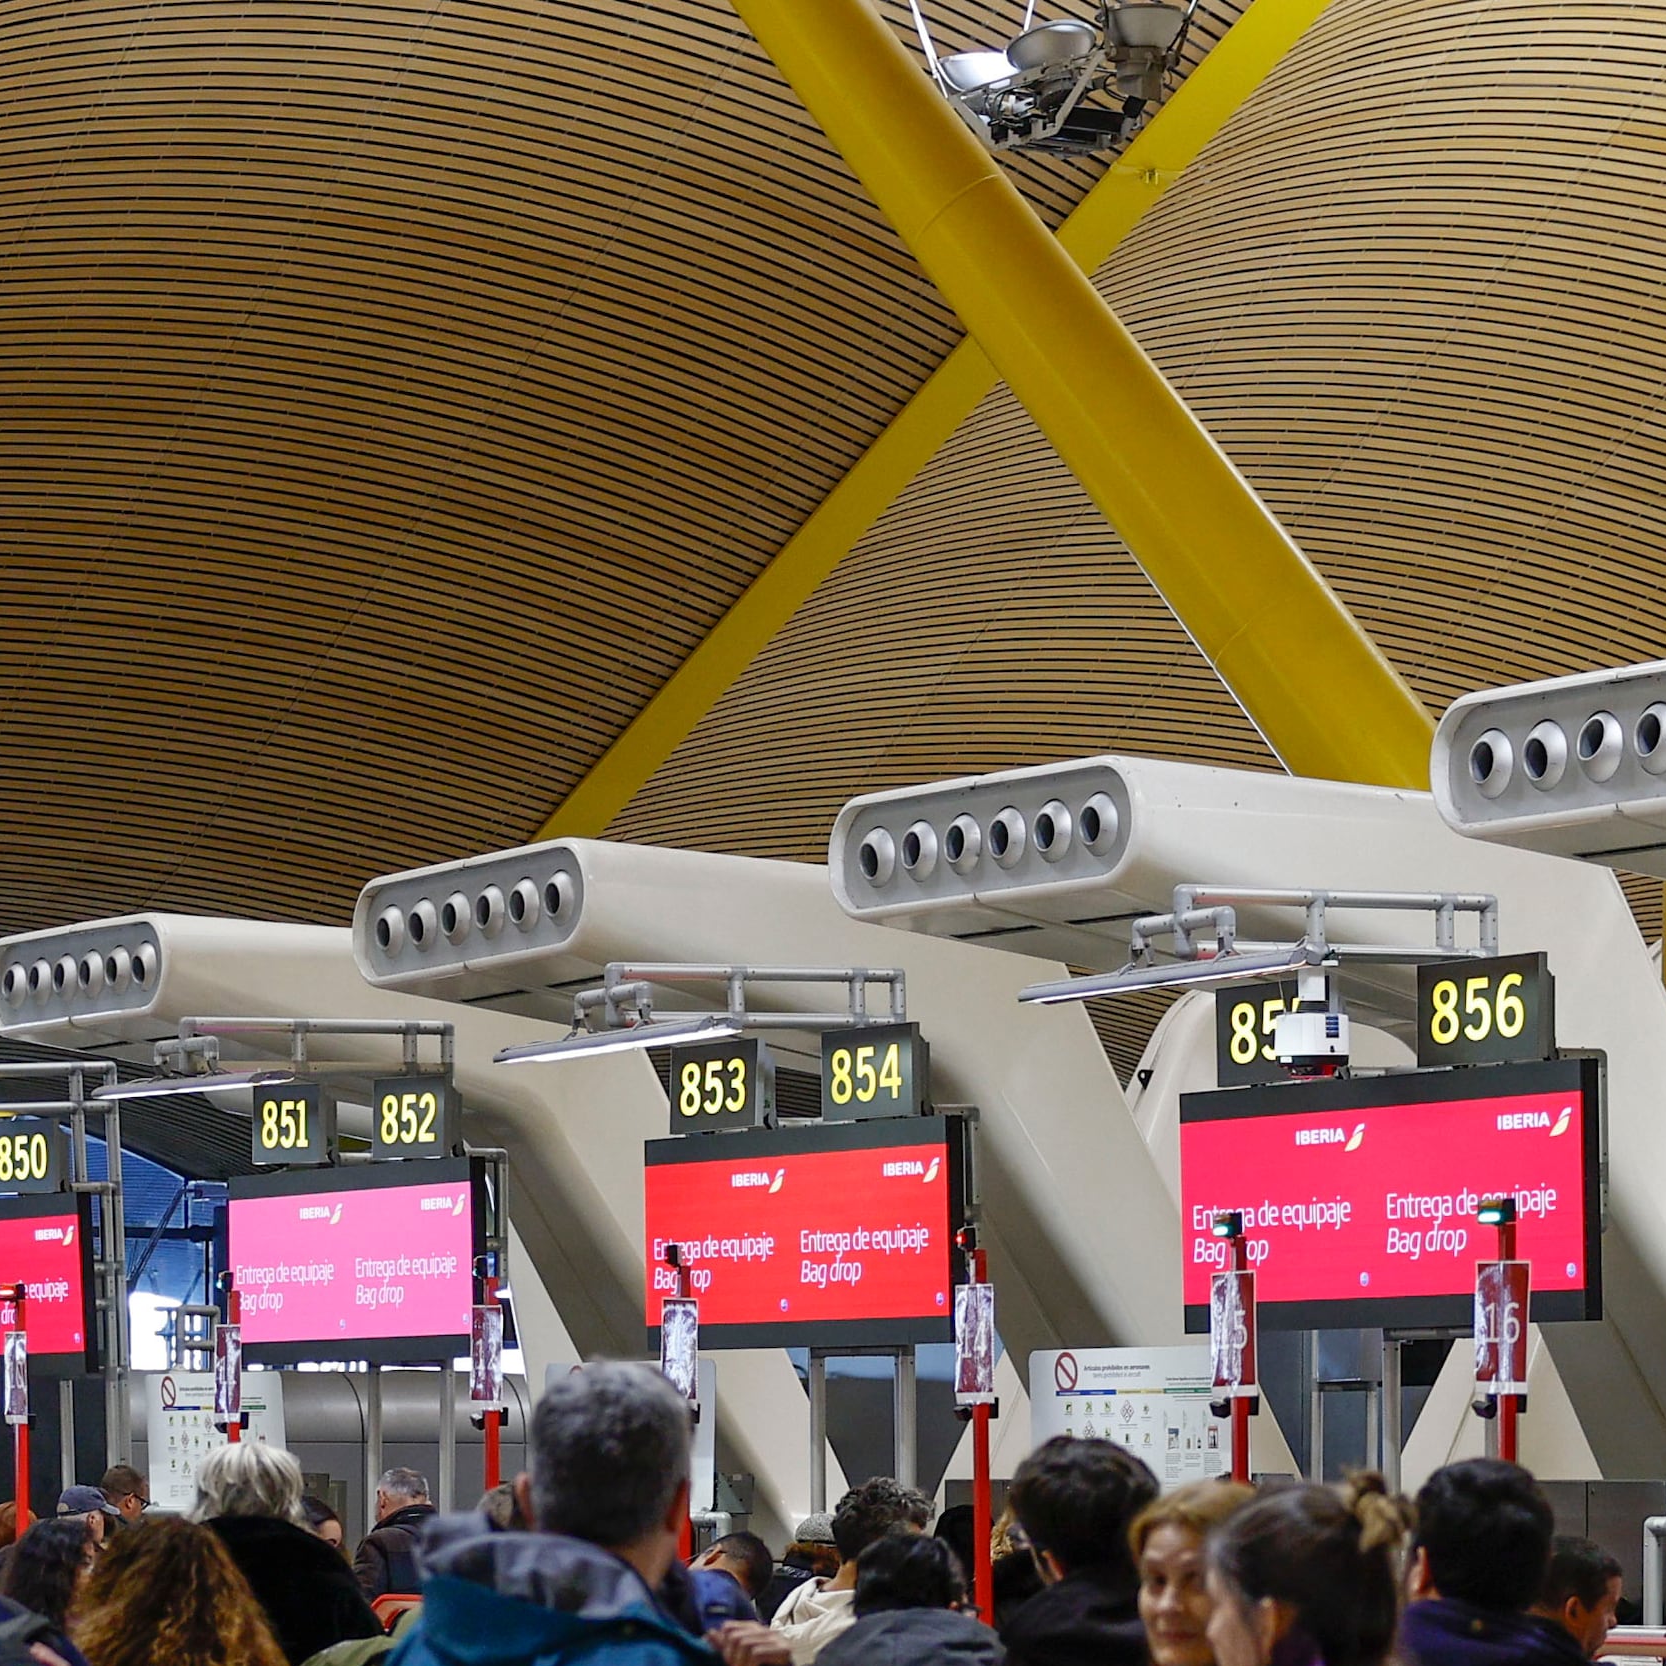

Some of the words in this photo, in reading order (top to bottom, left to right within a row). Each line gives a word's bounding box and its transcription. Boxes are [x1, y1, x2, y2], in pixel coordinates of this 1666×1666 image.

[1431, 973, 1525, 1045] 856
[1230, 997, 1301, 1065] 85
[680, 1057, 747, 1117] 853
[830, 1043, 902, 1105] 854
[261, 1099, 309, 1149] 851
[380, 1092, 436, 1145] 852
[1497, 1111, 1551, 1131] IBERIA
[1295, 1127, 1346, 1146] IBERIA
[731, 1172, 770, 1188] IBERIA
[882, 1160, 925, 1177] IBERIA
[299, 1205, 331, 1220] IBERIA
[420, 1196, 453, 1211] IBERIA
[1257, 1199, 1279, 1227] de
[1282, 1195, 1352, 1232] equipaje
[1386, 1191, 1452, 1224] Entrega
[1455, 1186, 1479, 1217] de
[1481, 1182, 1558, 1220] ipaje
[34, 1228, 64, 1242] IBERIA
[703, 1234, 719, 1259] de
[721, 1231, 774, 1262] equipaje
[800, 1228, 850, 1257] Entrega
[852, 1225, 870, 1251] de
[872, 1222, 929, 1255] equipaje
[1386, 1227, 1421, 1261] Bag
[1425, 1221, 1467, 1257] drop
[355, 1257, 396, 1282] Entrega
[397, 1253, 411, 1278] de
[412, 1250, 458, 1280] equipaje
[1193, 1237, 1226, 1270] Bag
[1244, 1238, 1270, 1267] op
[236, 1264, 275, 1289] Entrega
[276, 1261, 290, 1284] de
[290, 1258, 335, 1290] equipaje
[653, 1267, 679, 1295] Bag
[689, 1268, 711, 1293] rop
[800, 1259, 827, 1289] Bag
[830, 1258, 862, 1286] drop
[27, 1277, 69, 1303] equipaje
[258, 1289, 283, 1314] drop
[355, 1284, 377, 1310] Bag
[378, 1282, 405, 1307] drop
[1485, 1302, 1520, 1345] 16
